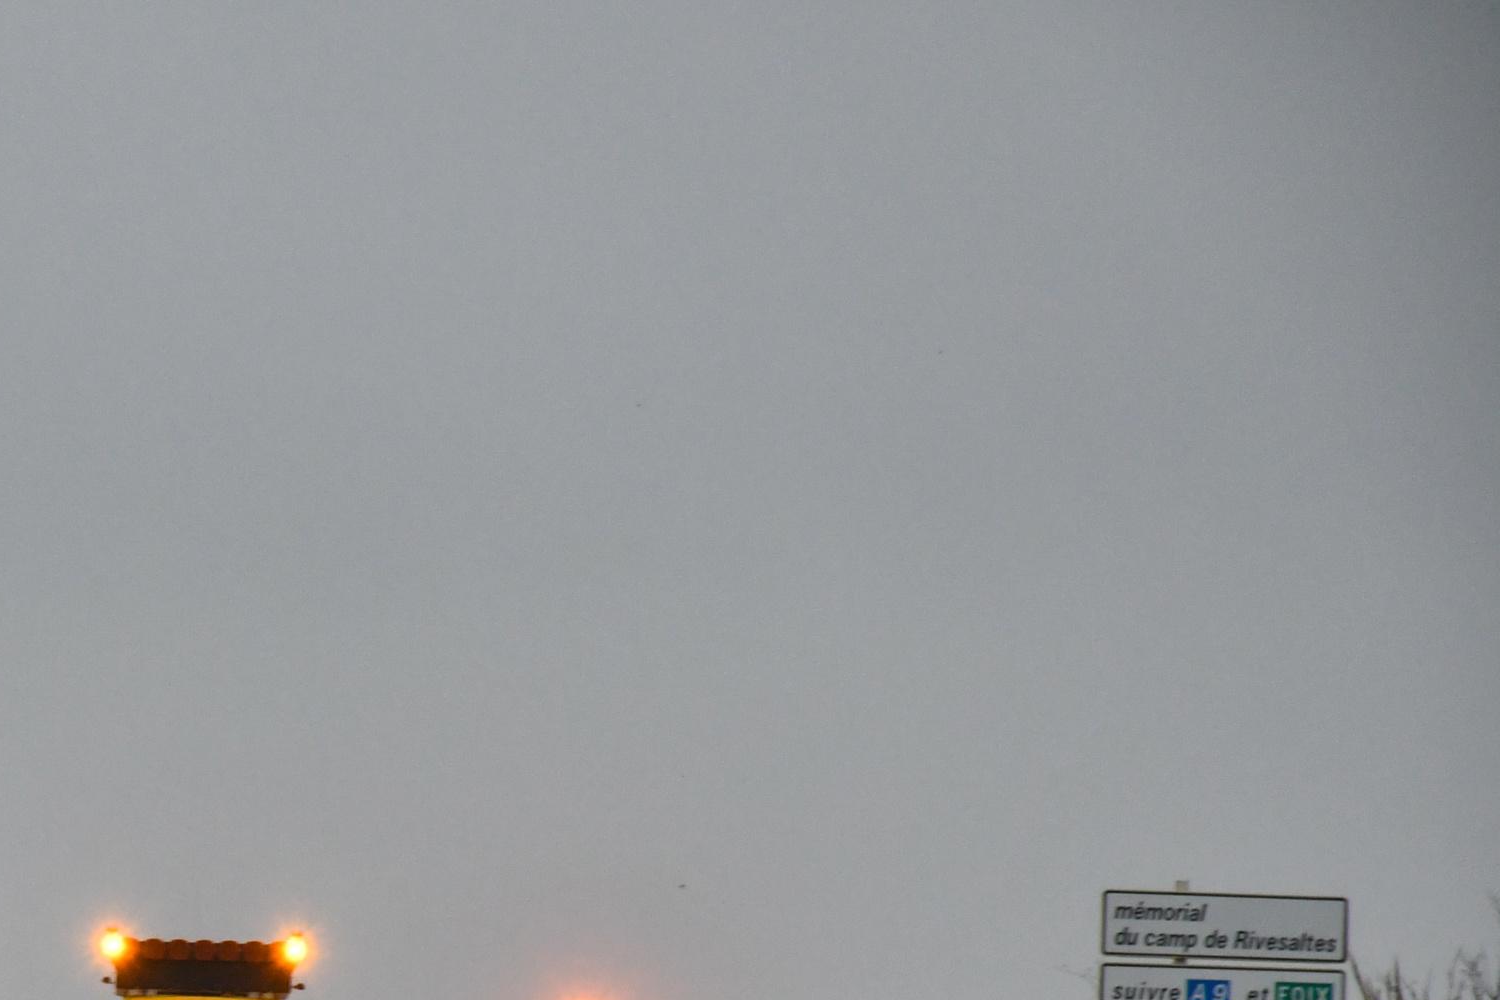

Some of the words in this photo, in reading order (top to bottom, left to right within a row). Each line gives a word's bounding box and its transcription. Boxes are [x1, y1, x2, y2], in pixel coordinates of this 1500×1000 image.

[1113, 901, 1208, 923] mémorial
[1114, 927, 1139, 947] du
[1144, 931, 1198, 952] camp
[1204, 929, 1228, 949] de
[1232, 930, 1338, 954] Rivesaltes
